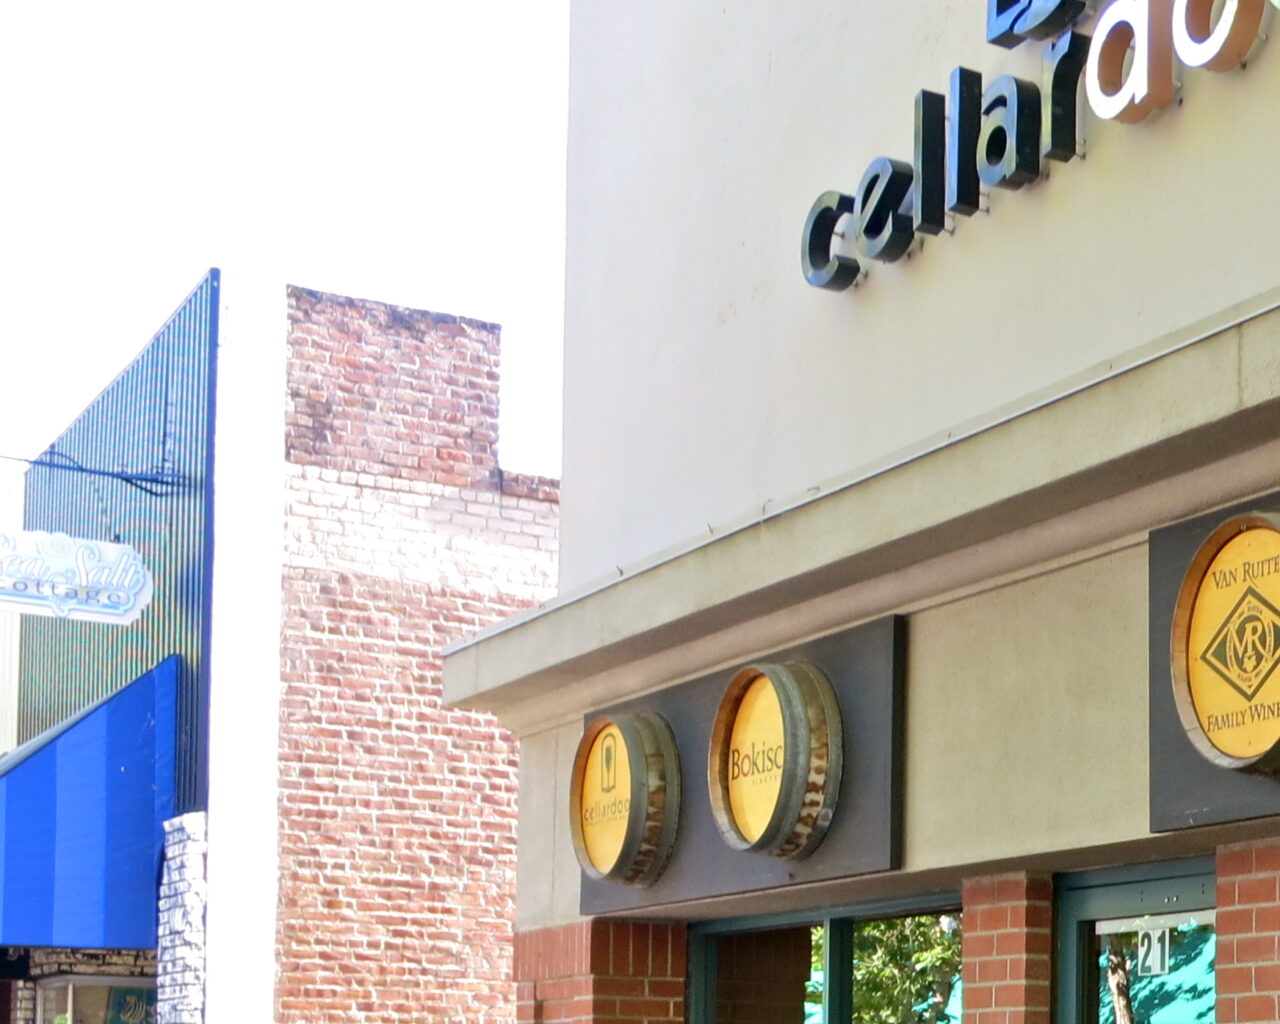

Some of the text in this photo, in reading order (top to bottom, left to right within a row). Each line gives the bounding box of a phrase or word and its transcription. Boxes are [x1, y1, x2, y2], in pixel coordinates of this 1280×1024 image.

[0, 577, 122, 605] ottage
[1212, 568, 1239, 589] VAN
[1206, 709, 1248, 733] FAMILY
[1140, 931, 1169, 975] 21
